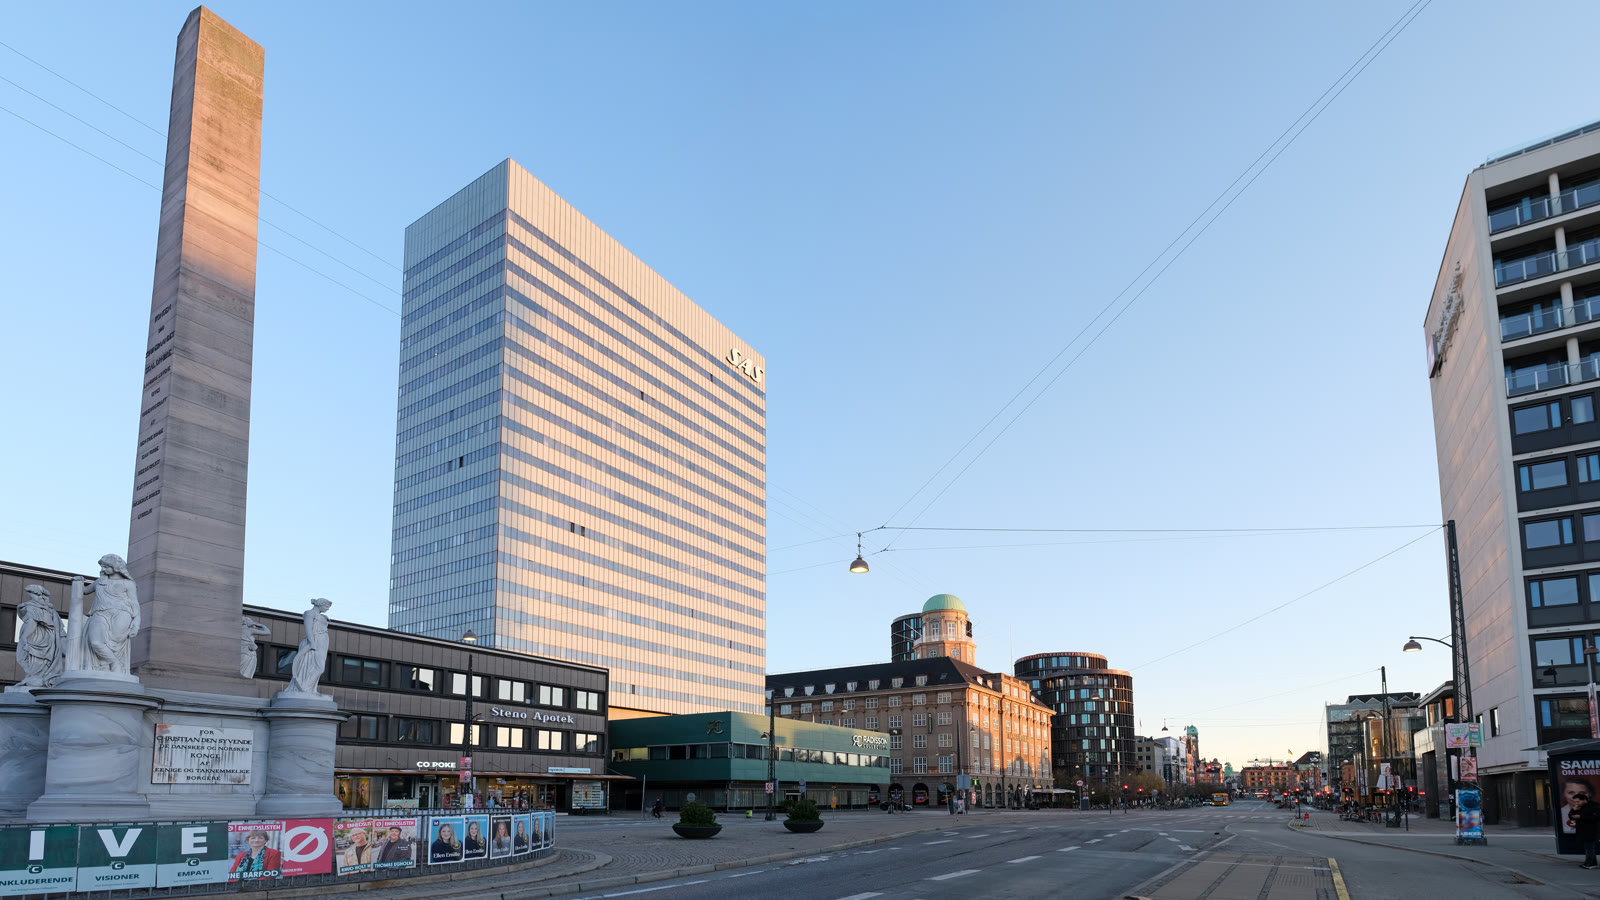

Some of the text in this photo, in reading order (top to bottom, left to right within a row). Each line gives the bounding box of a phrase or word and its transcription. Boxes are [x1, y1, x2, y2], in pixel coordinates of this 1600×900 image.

[726, 348, 763, 383] SAS
[491, 706, 574, 723] Steno Apotek
[863, 736, 888, 745] RADISSON
[29, 831, 45, 860] I
[97, 828, 142, 857] V
[181, 827, 207, 854] E
[243, 870, 278, 878] BARFOD
